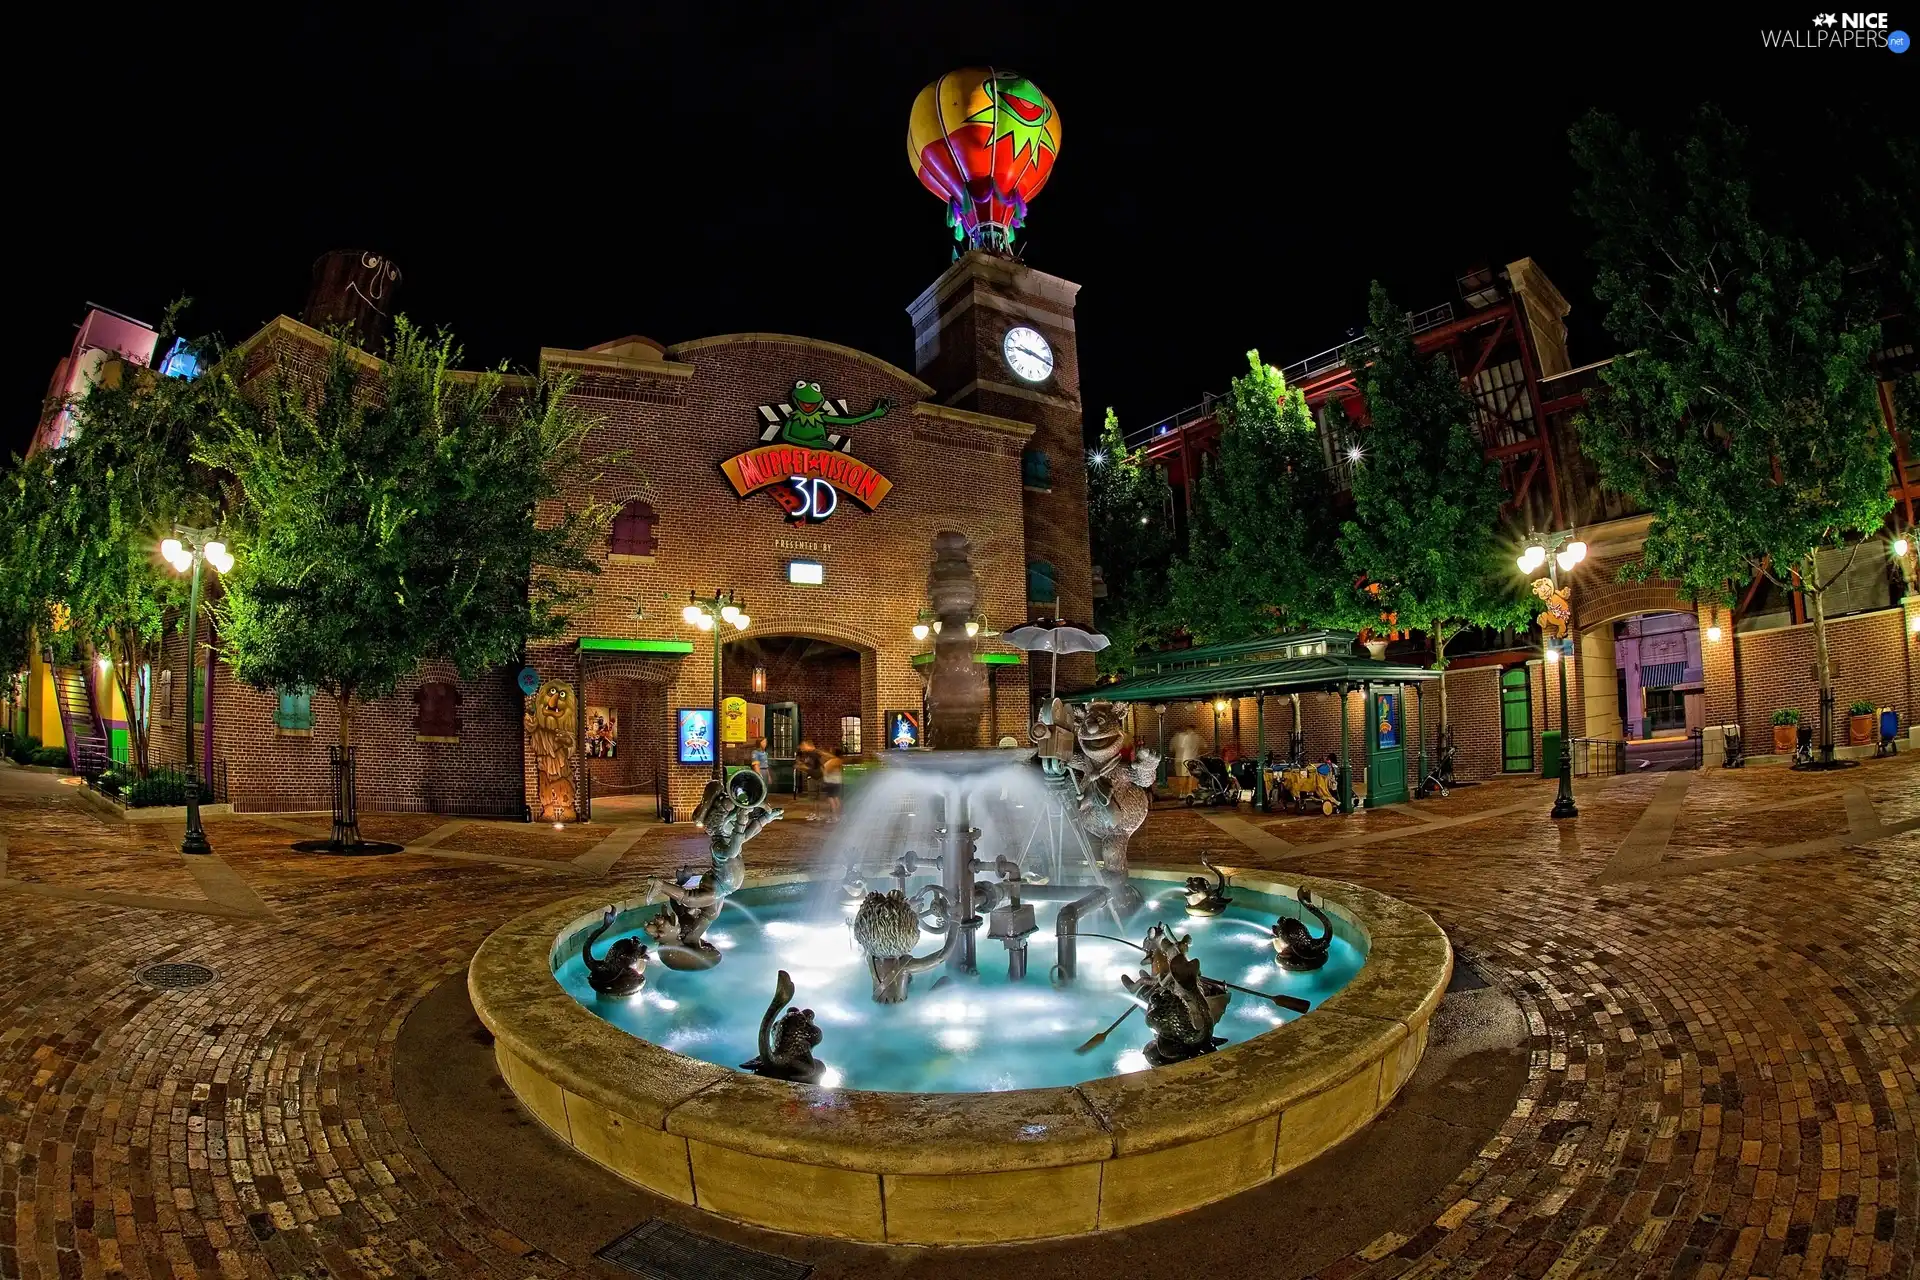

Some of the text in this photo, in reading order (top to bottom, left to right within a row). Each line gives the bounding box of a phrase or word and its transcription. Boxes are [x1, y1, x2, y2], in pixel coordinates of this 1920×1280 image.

[737, 449, 880, 500] MUPPET VISION
[790, 476, 837, 518] 3D
[775, 539, 832, 552] PRESENTED BY
